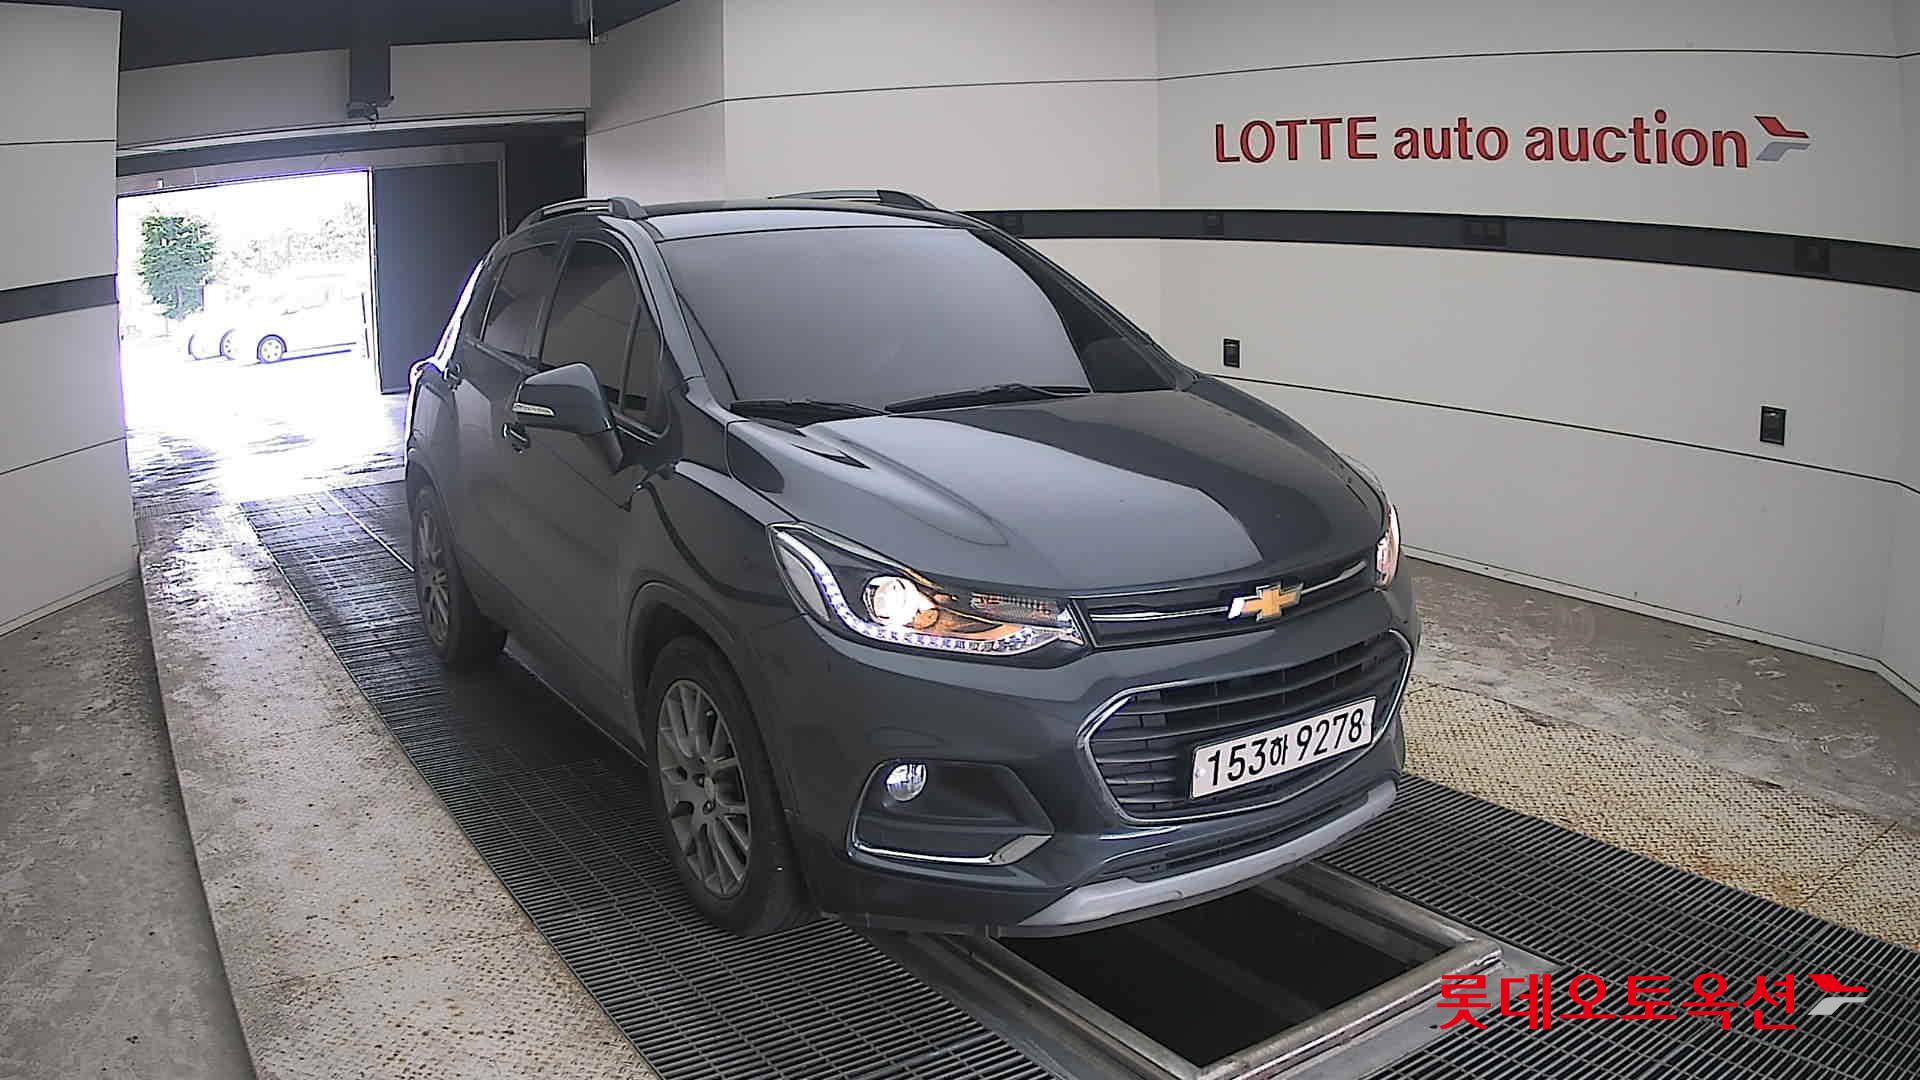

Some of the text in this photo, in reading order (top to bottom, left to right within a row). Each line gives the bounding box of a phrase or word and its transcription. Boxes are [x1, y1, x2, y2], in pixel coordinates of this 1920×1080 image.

[1214, 109, 1749, 168] LOTTE auto auction
[1207, 708, 1364, 786] 153하 9278
